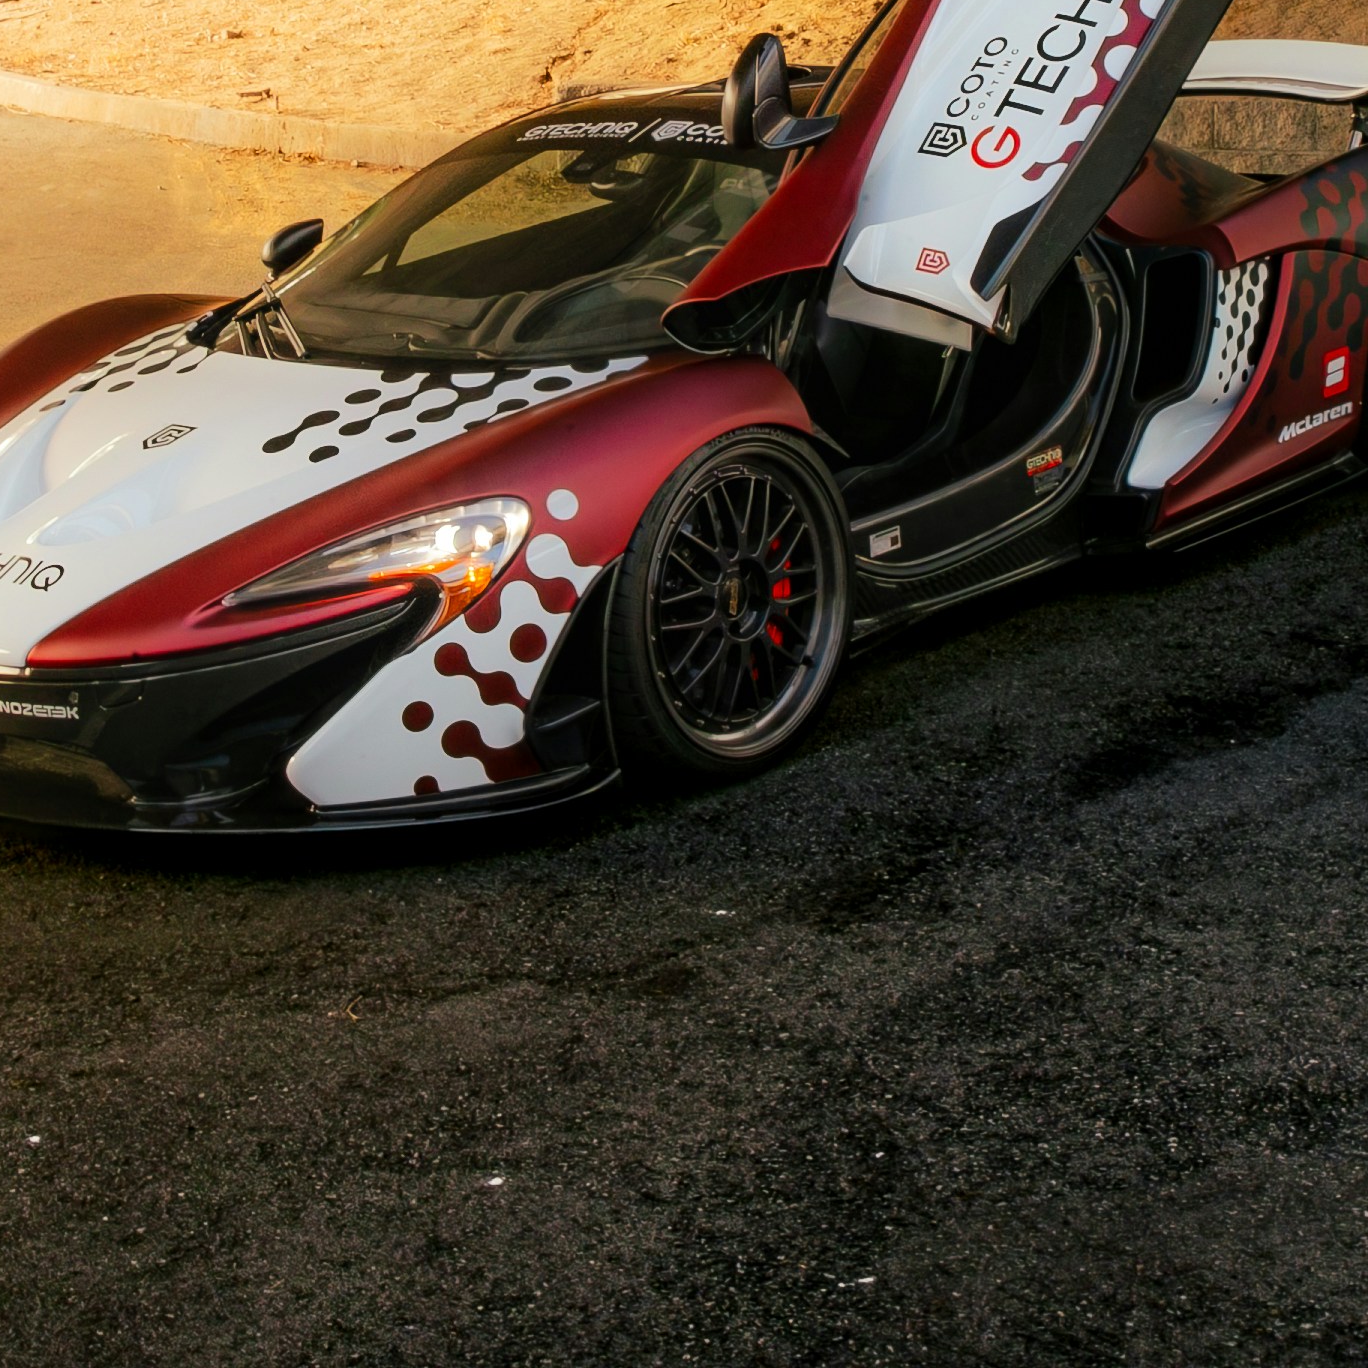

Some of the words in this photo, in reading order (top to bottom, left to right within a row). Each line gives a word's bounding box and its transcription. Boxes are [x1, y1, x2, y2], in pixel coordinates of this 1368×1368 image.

[946, 36, 1009, 118] COTO
[524, 121, 639, 138] GTECHNIQ
[686, 123, 725, 137] CO
[1277, 401, 1354, 444] McLaren
